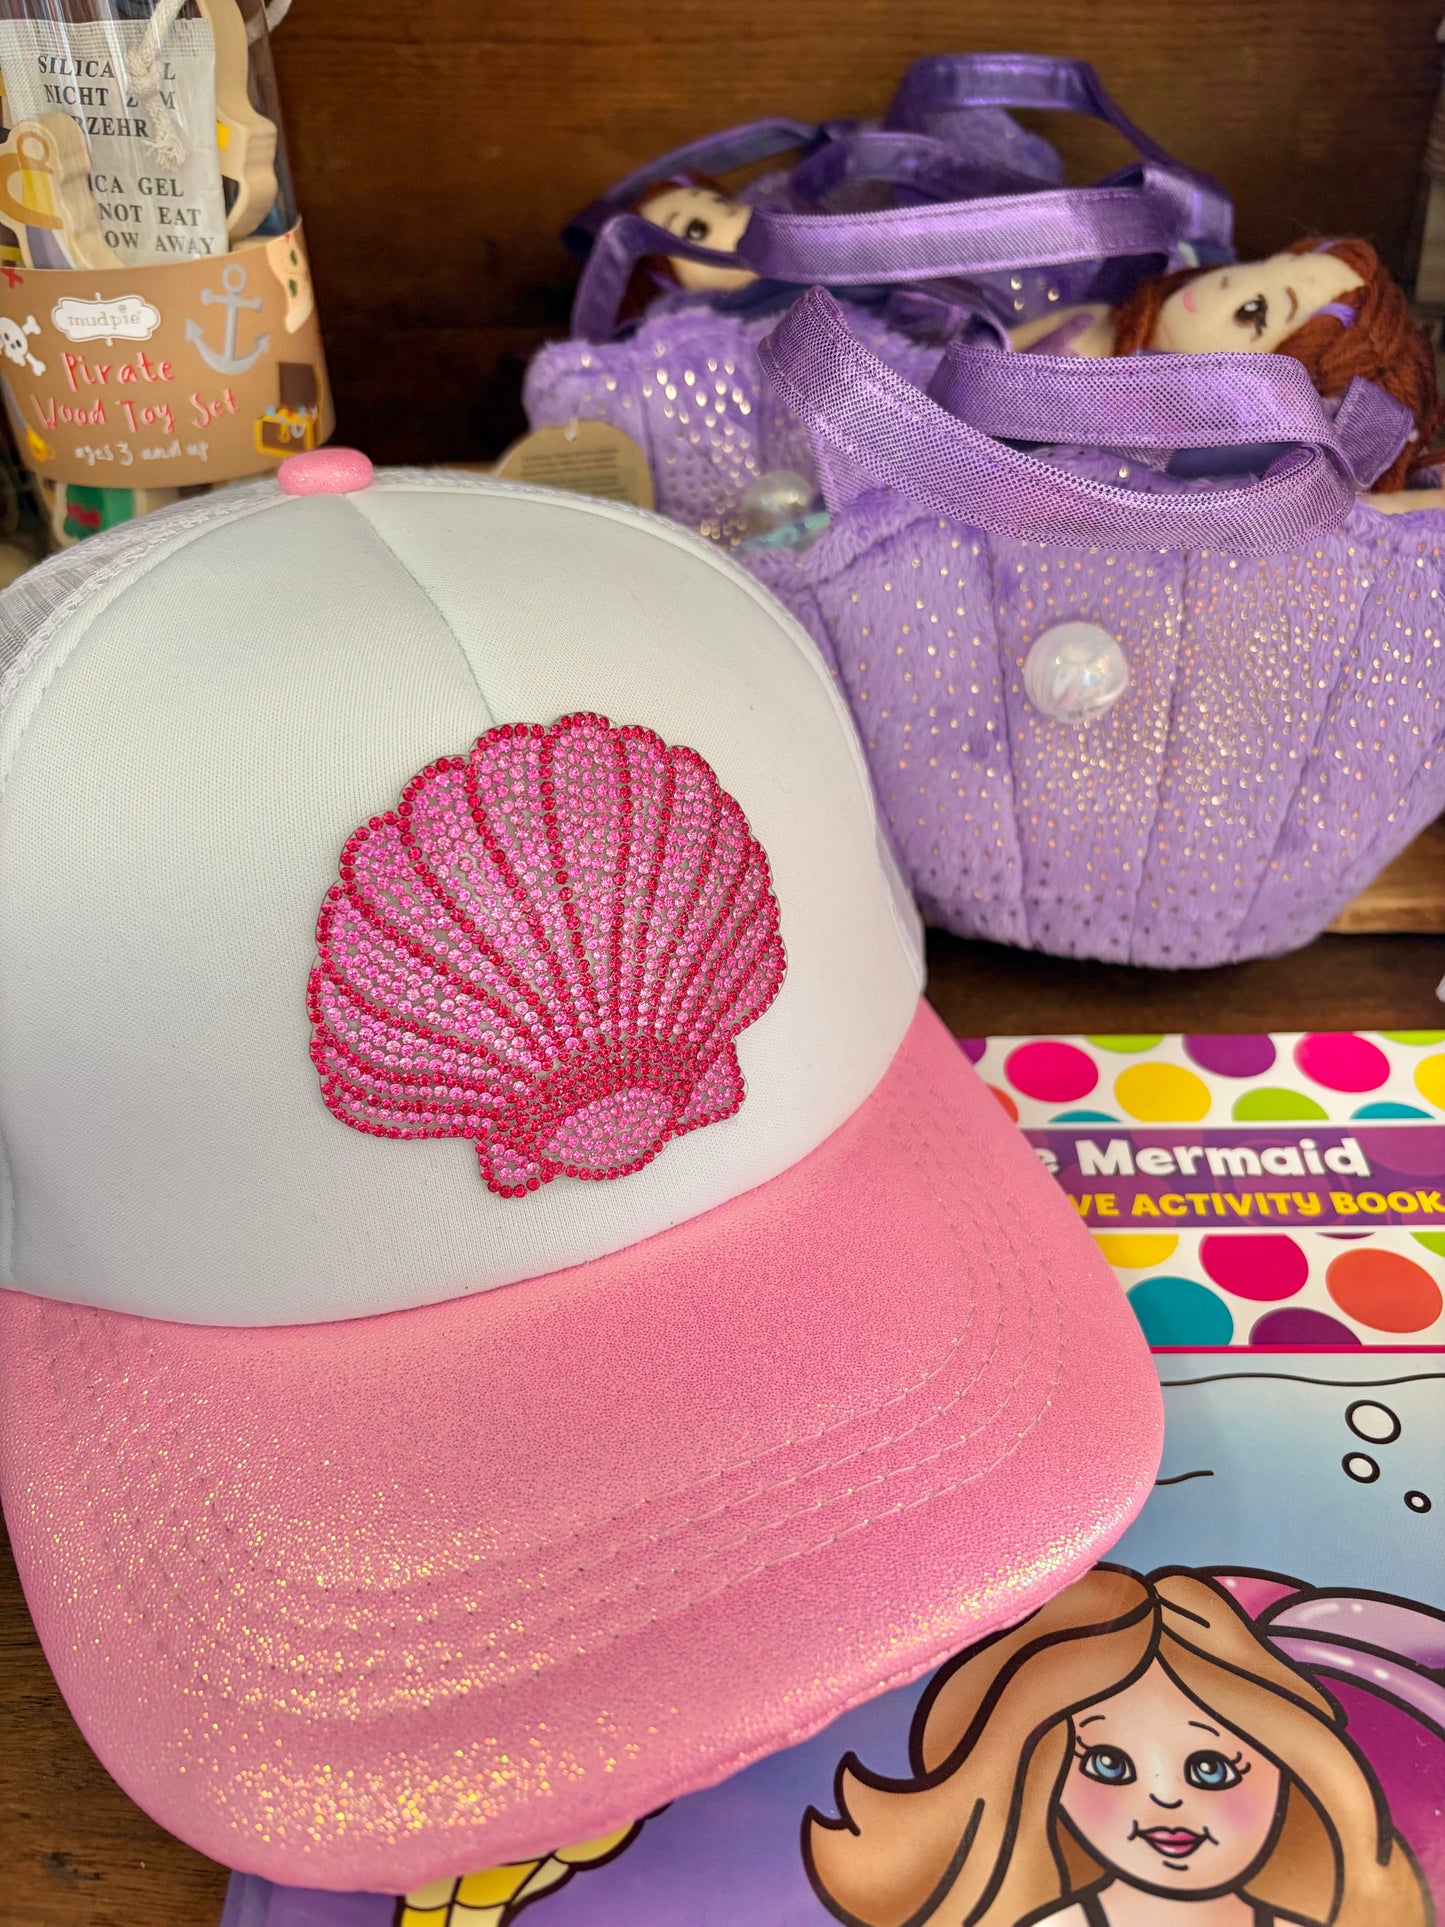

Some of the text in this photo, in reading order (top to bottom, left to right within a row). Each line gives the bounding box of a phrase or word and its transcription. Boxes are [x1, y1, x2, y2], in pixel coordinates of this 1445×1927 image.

[38, 55, 115, 78] SILICA
[44, 84, 109, 106] NICHT
[138, 176, 184, 197] GEL
[98, 202, 200, 227] NOT EAT
[154, 234, 214, 255] AWAY
[67, 304, 141, 330] mudpie
[61, 351, 174, 392] Pirate
[30, 387, 240, 435] Wood Toy Set
[74, 438, 209, 466] ages 3 and up
[1074, 1137, 1371, 1177] Mermaid
[1131, 1191, 1322, 1217] ACTIVITY
[1328, 1190, 1445, 1216] BOOK
